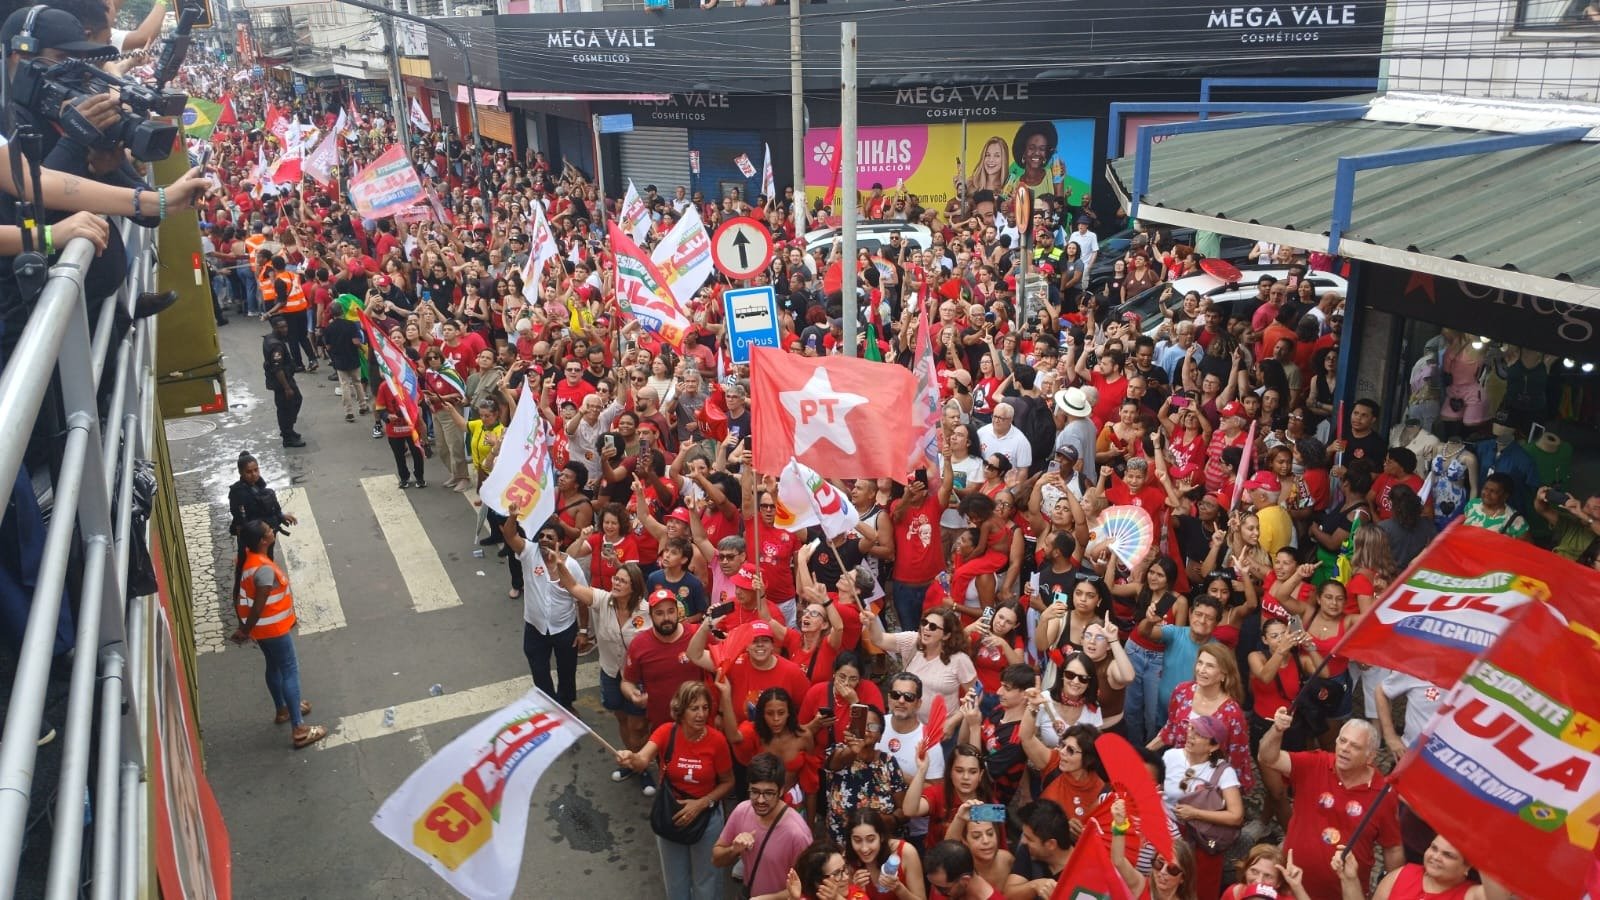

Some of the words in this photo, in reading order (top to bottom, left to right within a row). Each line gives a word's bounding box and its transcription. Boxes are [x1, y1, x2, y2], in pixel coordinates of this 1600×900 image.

[1207, 7, 1283, 28] MEGA
[1291, 5, 1357, 25] VALE
[548, 30, 600, 48] MEGA
[605, 29, 656, 47] VALE
[1240, 31, 1320, 43] COSMÉTICOS
[684, 90, 730, 108] VALE
[895, 86, 963, 105] MEGA
[970, 82, 1029, 101] VALE
[651, 110, 706, 121] COSMÉTICOS
[842, 138, 912, 165] HIKAS
[929, 192, 947, 203] você
[618, 278, 676, 320] ULA
[799, 398, 839, 425] PT
[1434, 747, 1528, 806] ALCKMIN
